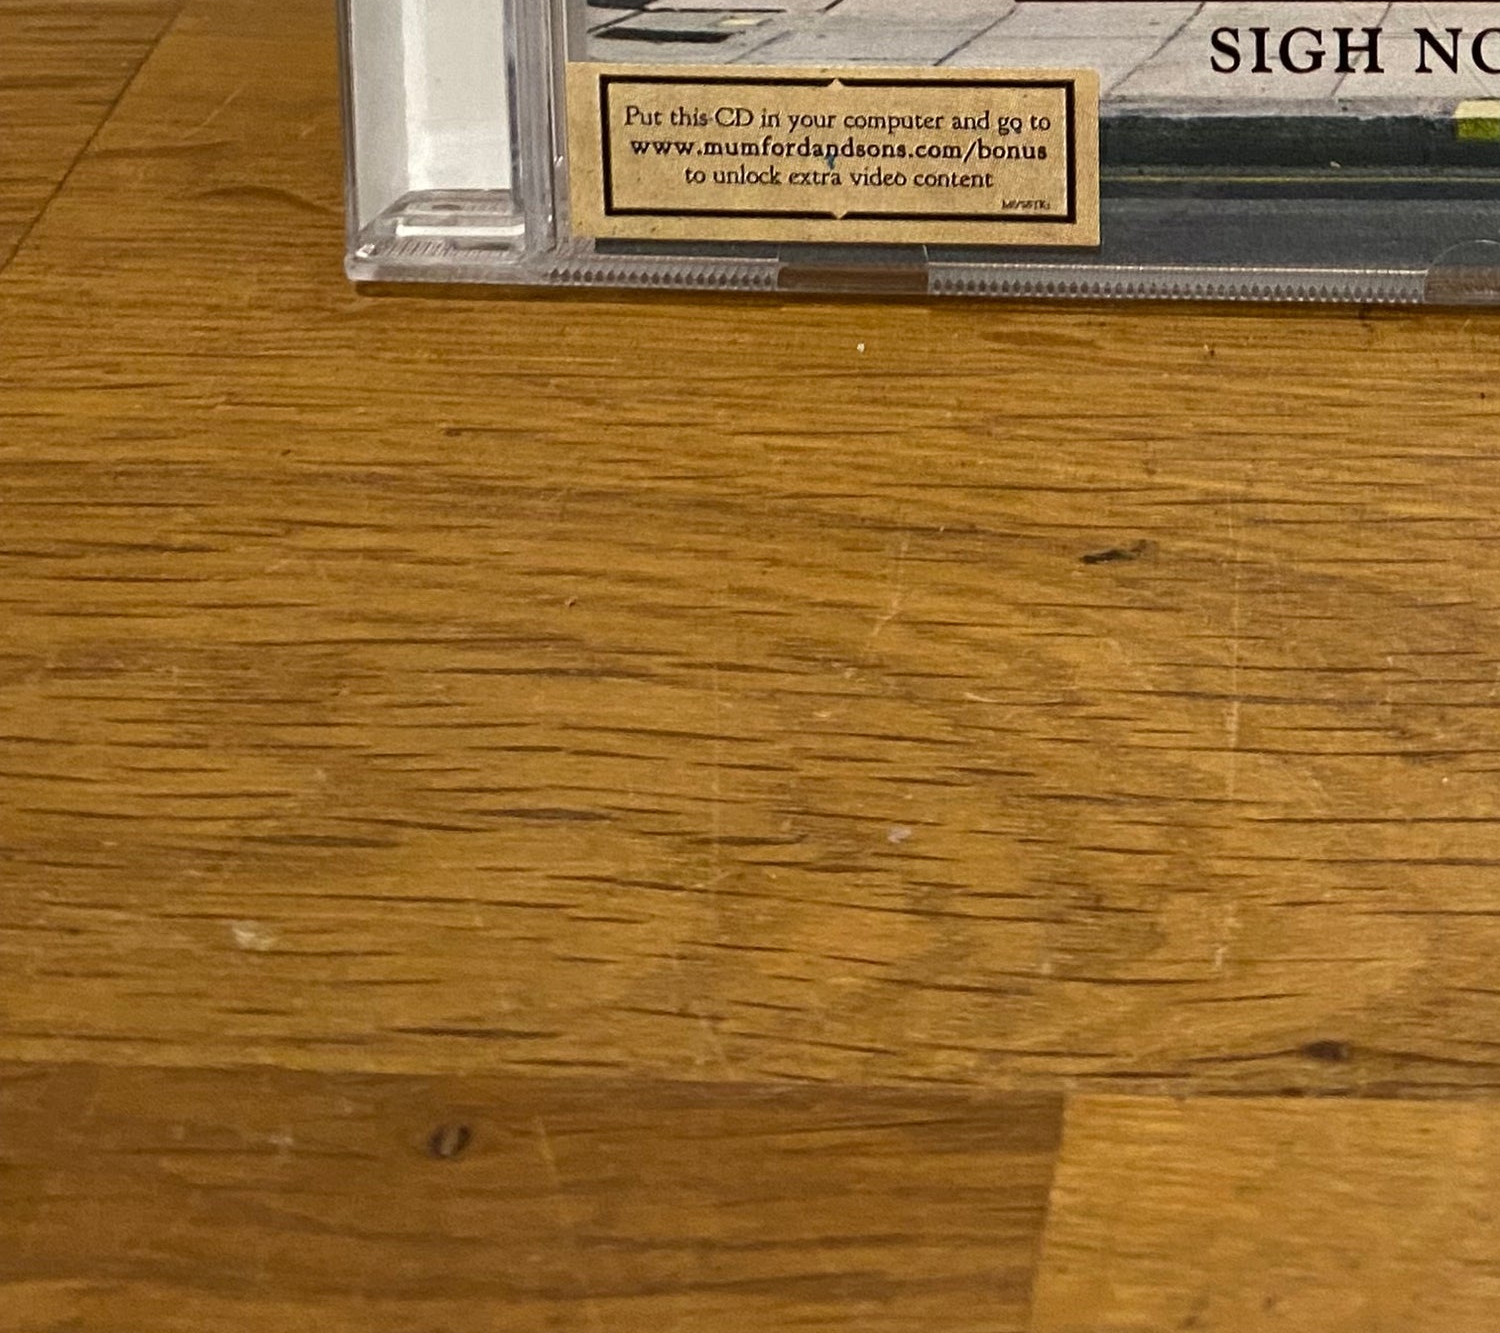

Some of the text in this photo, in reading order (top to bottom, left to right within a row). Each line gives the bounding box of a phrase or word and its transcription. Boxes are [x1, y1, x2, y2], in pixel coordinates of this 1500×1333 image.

[1210, 27, 1385, 74] SIGH
[624, 106, 1051, 136] Put this CD in your computer and go to
[630, 136, 1048, 163] www.mumfordandsons.com/bonus
[685, 164, 993, 188] to unlock extra video content
